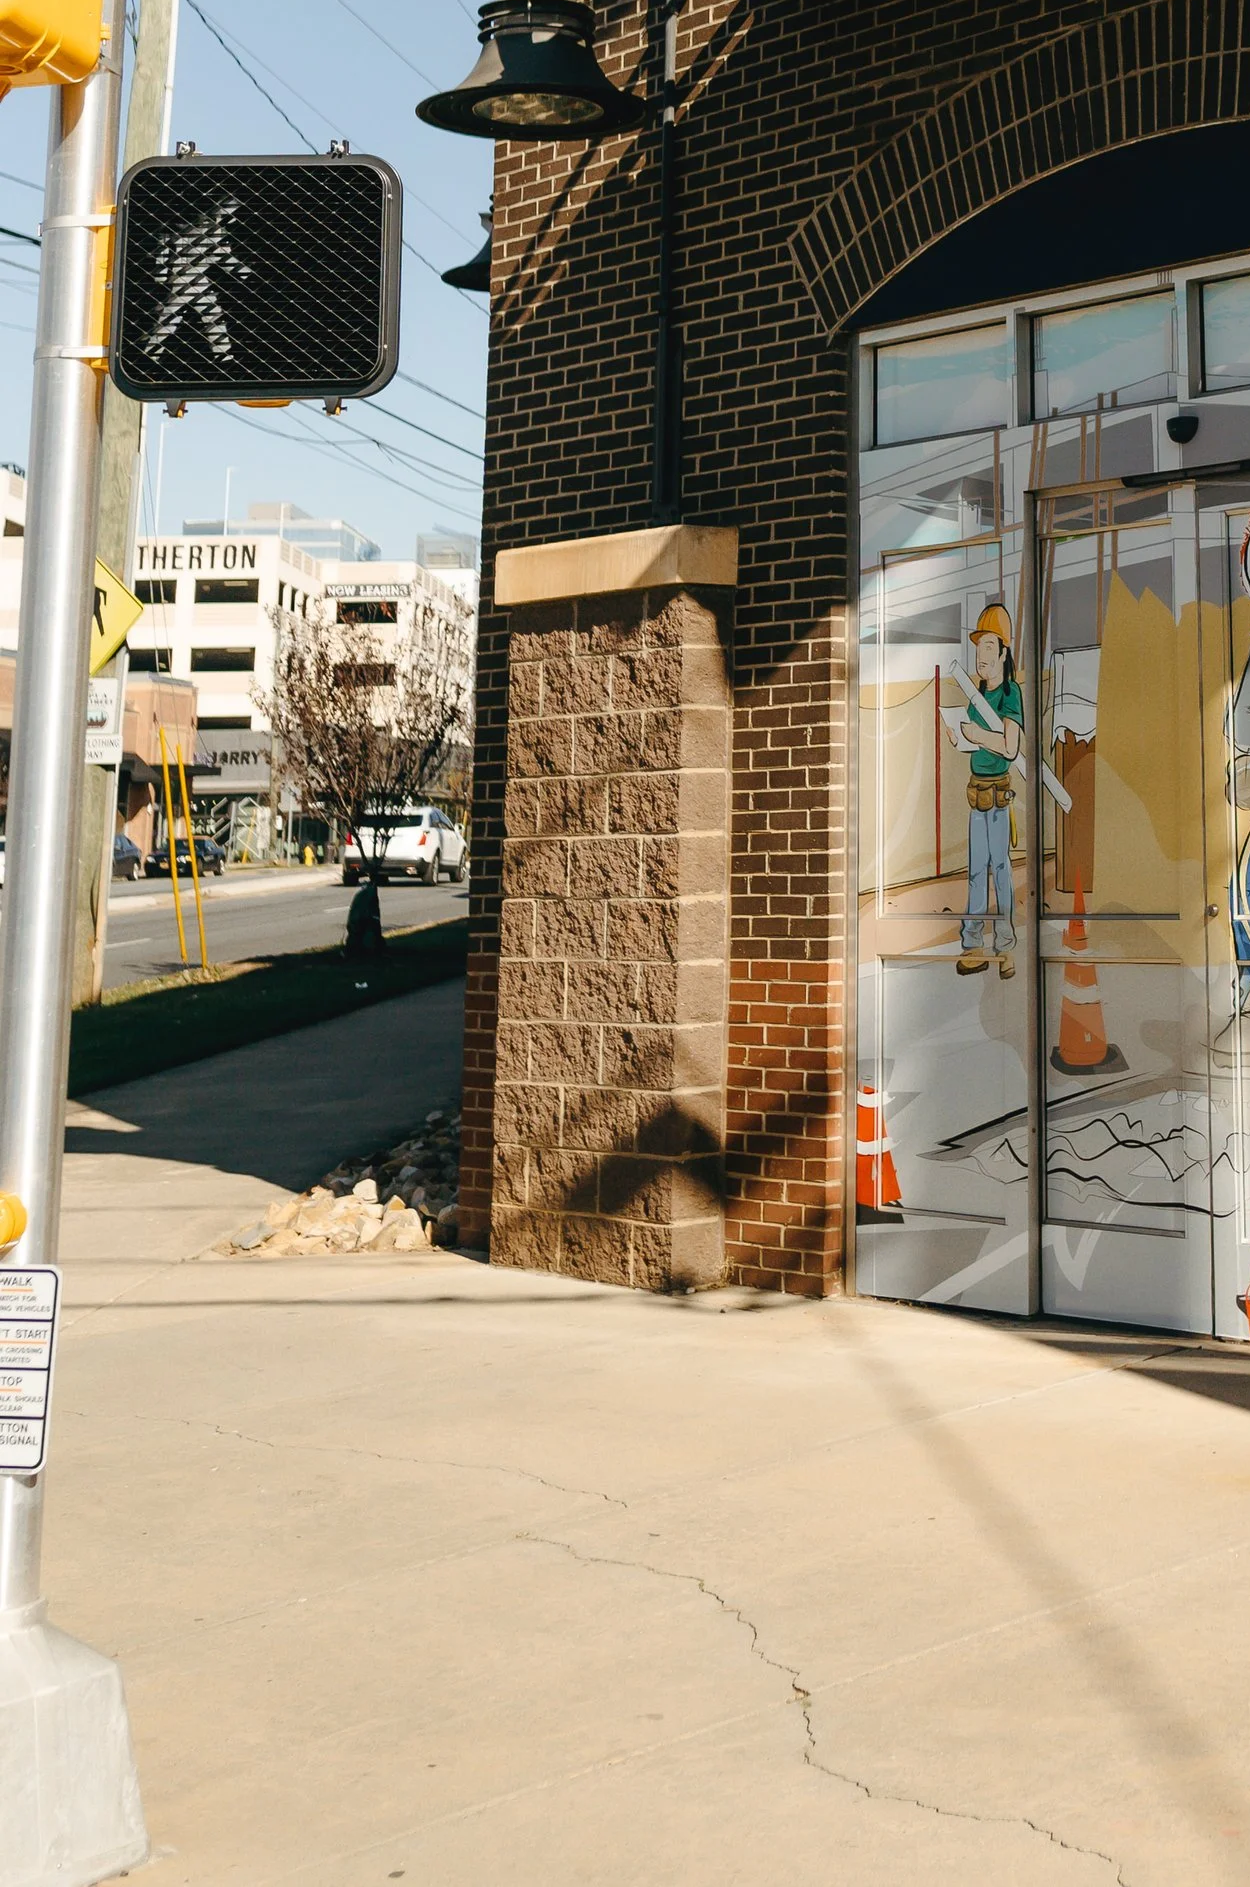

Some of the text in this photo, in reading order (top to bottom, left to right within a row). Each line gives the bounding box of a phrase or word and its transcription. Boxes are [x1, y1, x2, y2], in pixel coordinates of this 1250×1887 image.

[137, 544, 257, 570] THERTON
[327, 585, 408, 596] NOW LEASING
[86, 738, 120, 749] LOTHING
[16, 1329, 48, 1339] START
